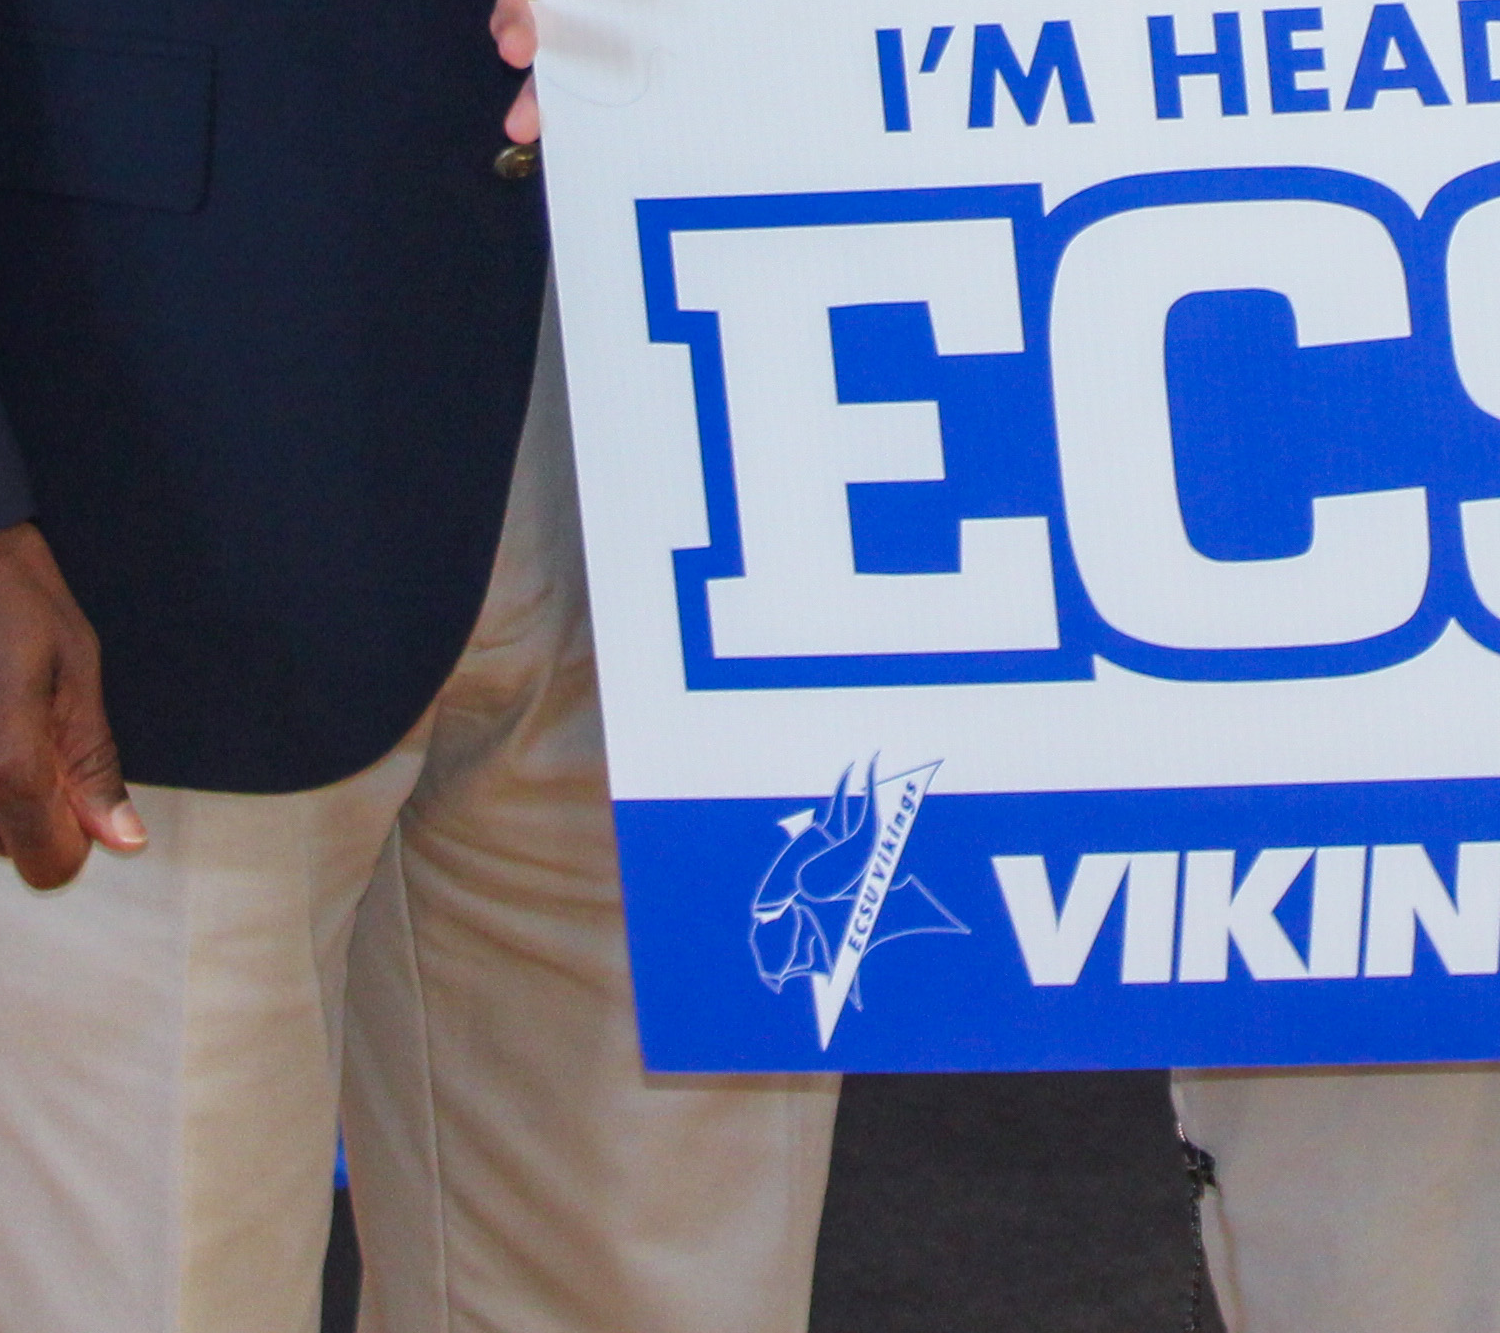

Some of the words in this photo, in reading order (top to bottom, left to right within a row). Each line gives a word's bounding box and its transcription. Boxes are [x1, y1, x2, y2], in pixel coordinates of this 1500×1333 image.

[874, 18, 1096, 133] I'M
[847, 885, 879, 952] ECSU
[871, 780, 918, 882] Vikings
